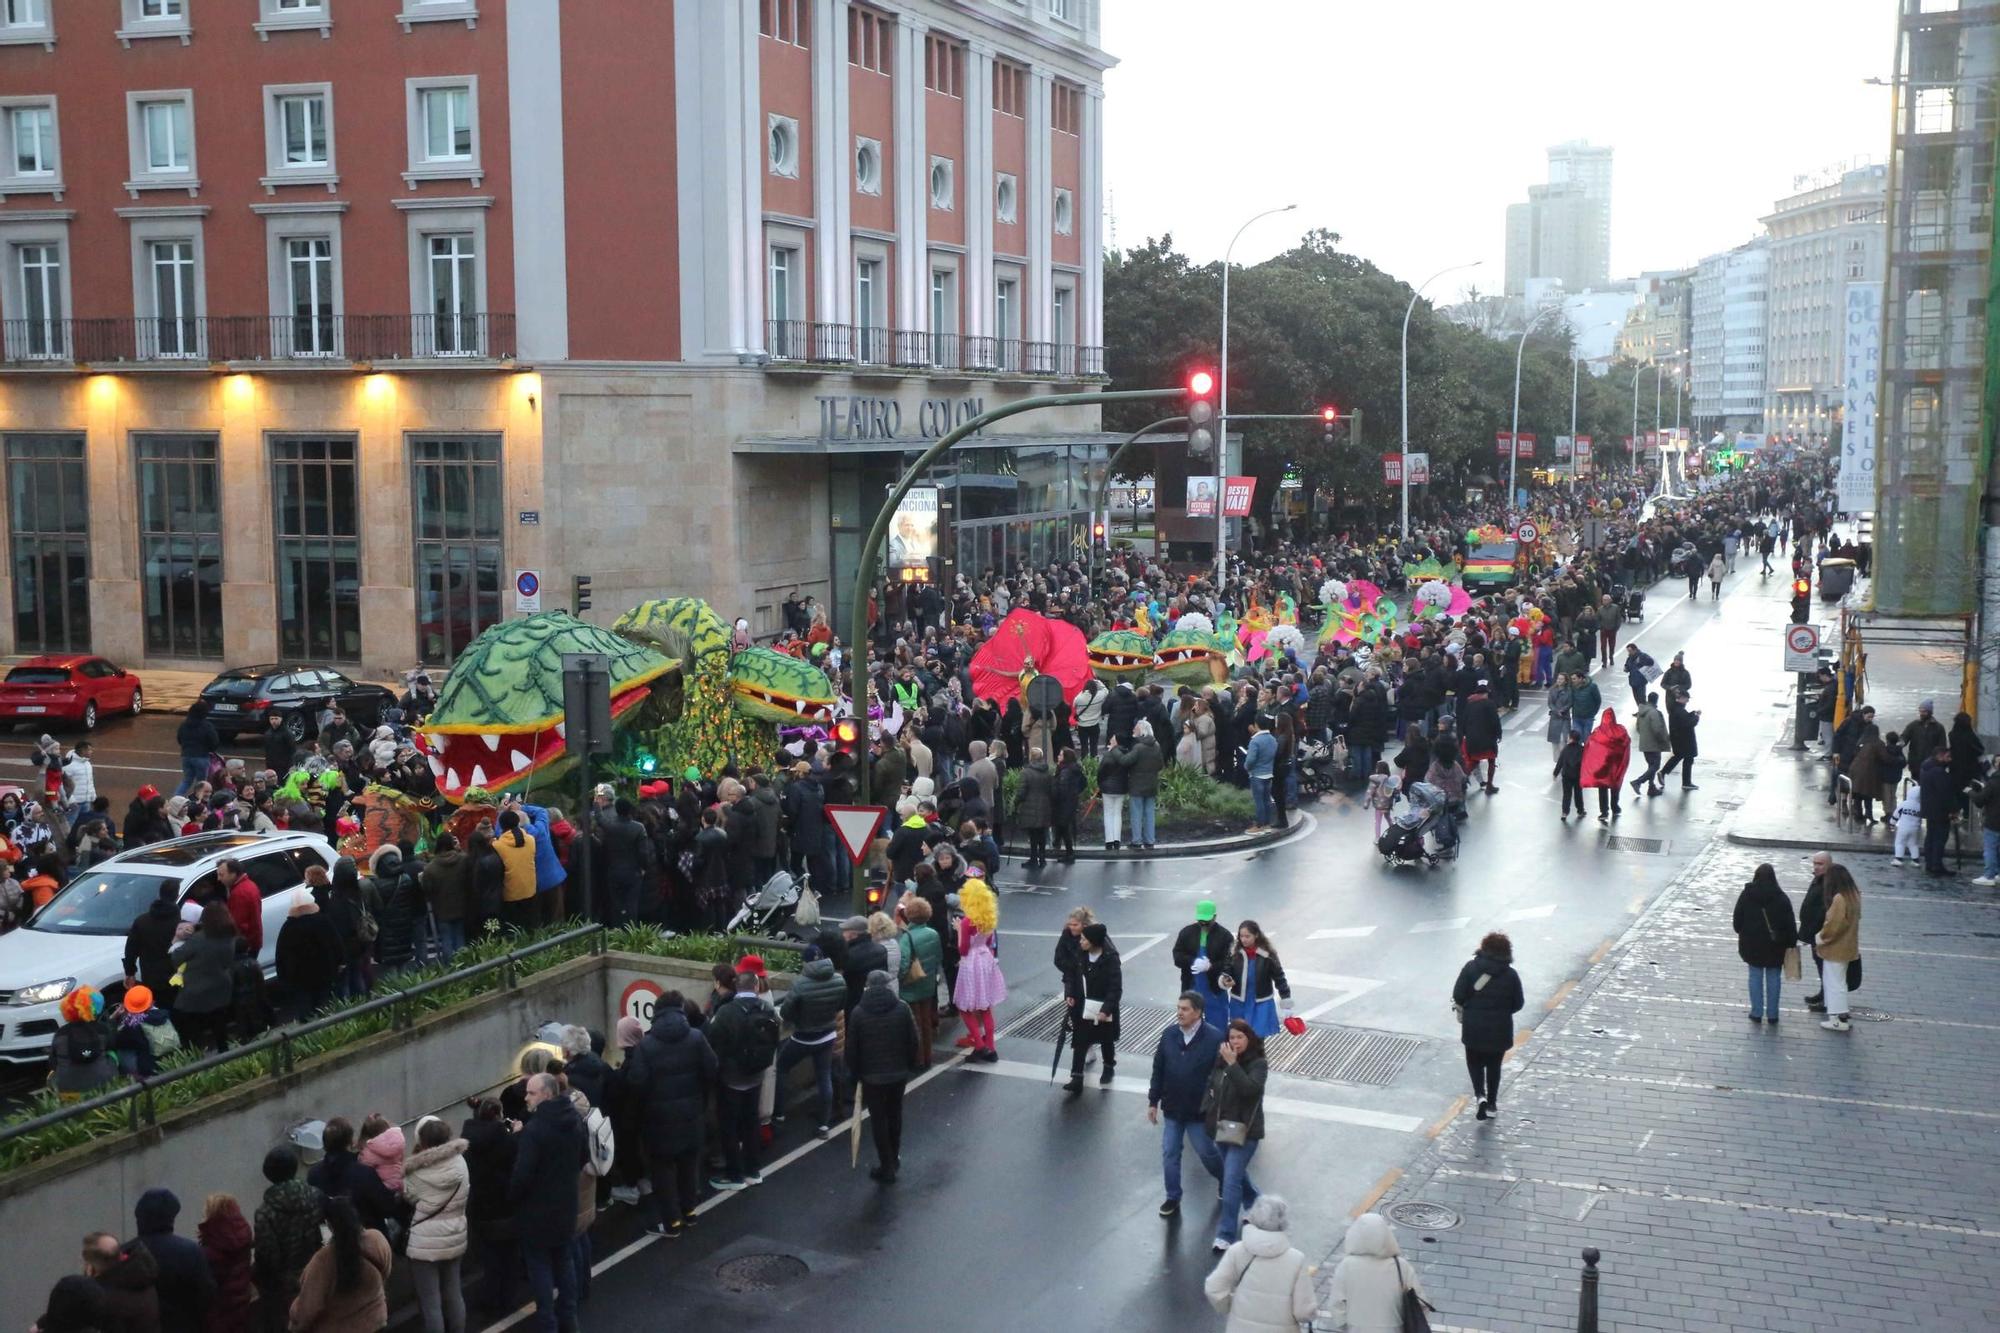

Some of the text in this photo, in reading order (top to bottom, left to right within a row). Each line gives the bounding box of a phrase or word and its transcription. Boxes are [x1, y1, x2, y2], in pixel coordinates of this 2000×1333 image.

[815, 395, 902, 440] TEATRO
[1226, 496, 1248, 511] VAI!
[1521, 529, 1534, 538] 30
[902, 568, 913, 581] 10
[633, 1000, 655, 1021] 10
